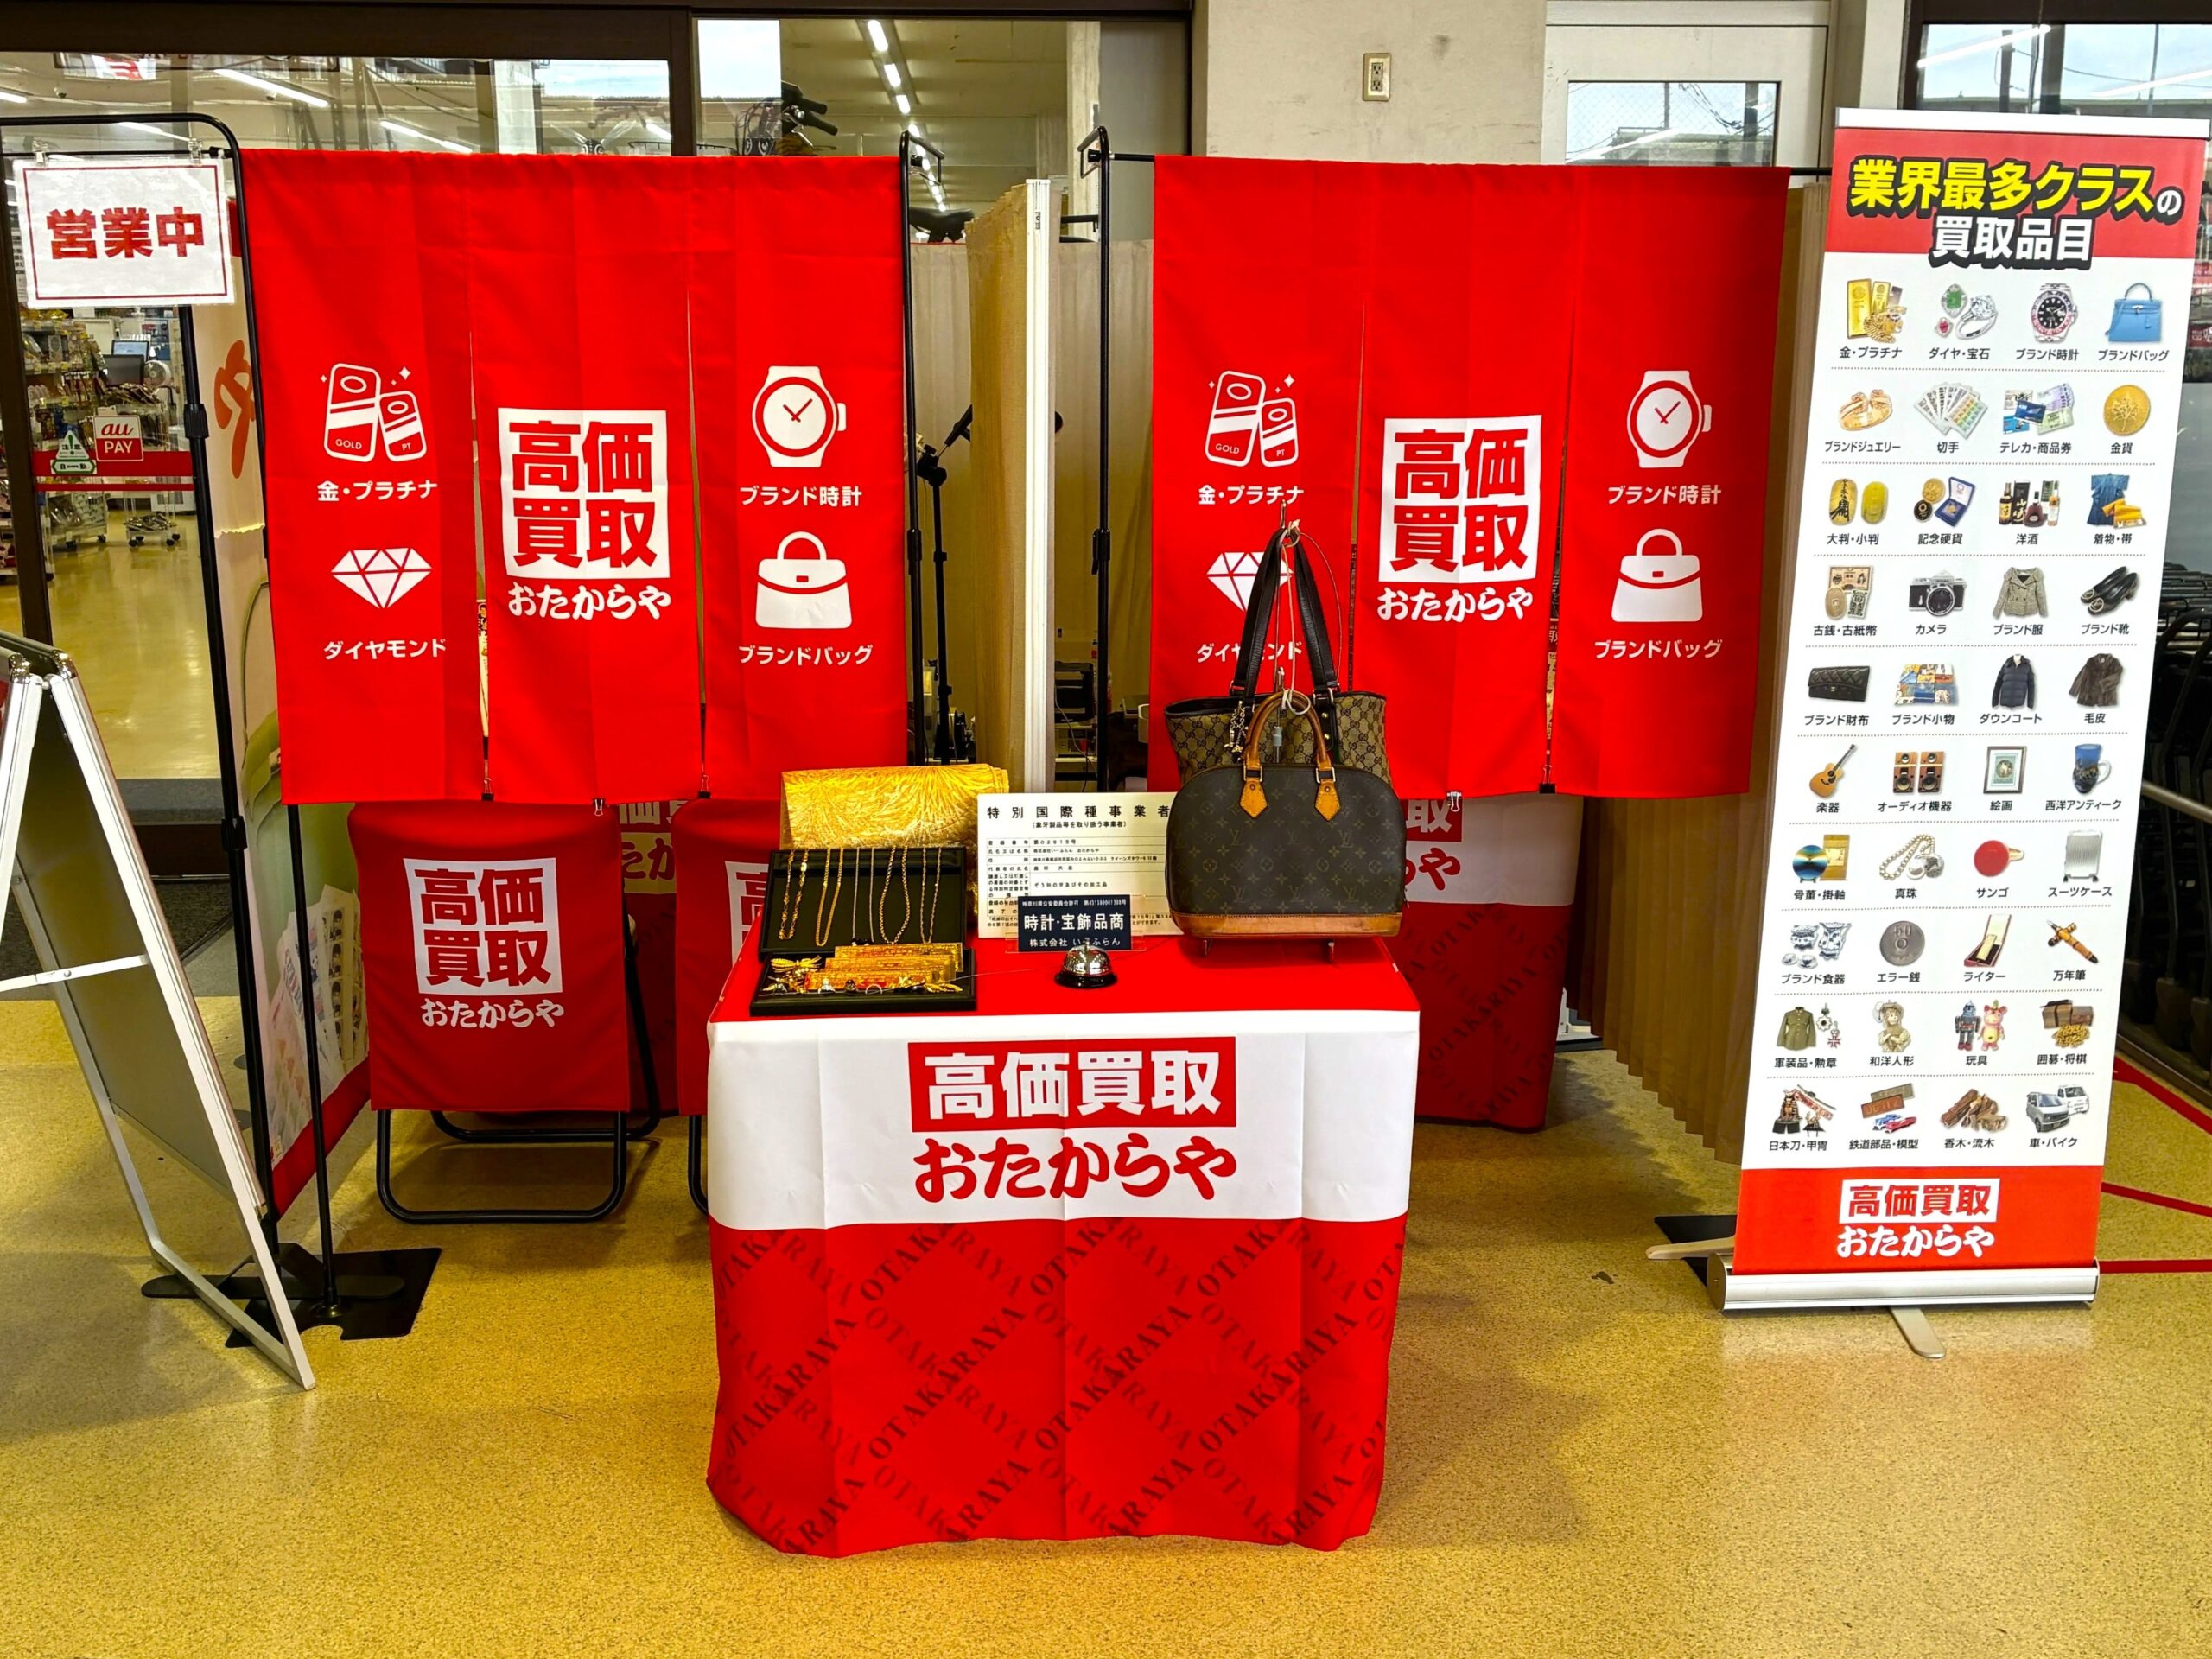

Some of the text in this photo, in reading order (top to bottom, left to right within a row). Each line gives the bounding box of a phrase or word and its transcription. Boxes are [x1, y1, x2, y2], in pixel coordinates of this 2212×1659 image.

[1849, 157, 2183, 216] 業界最多クラスの
[48, 207, 204, 258] 営業中
[1932, 214, 2093, 263] 買取品目
[1840, 346, 1903, 359] 金・プラチナ
[1929, 347, 1990, 360] ダイヤ・宝石
[2016, 348, 2080, 361] ブランド時計
[2098, 350, 2170, 361] ブランドバッグ
[100, 422, 135, 436] au
[104, 440, 134, 454] PAY
[334, 438, 363, 450] GOLD
[401, 442, 412, 452] PT
[1215, 443, 1240, 454] GOLD
[1825, 441, 1901, 453] ブランドジュエリー
[1936, 442, 1959, 454] 切手
[2000, 442, 2071, 454] テレカ・商品券
[2110, 442, 2133, 454] 金貨
[509, 420, 653, 493] 高価
[1275, 448, 1286, 457] PT
[1395, 429, 1528, 499] 高価
[318, 480, 436, 501] 金・プラチナ
[741, 486, 861, 506] ブランド時計
[1199, 485, 1303, 504] 金・プラチナ
[1609, 485, 1720, 504] ブランド時計
[512, 497, 657, 568] 買取
[1390, 504, 1529, 573] 買取
[1917, 532, 1963, 545] 記念硬貨
[1827, 533, 1879, 545] 大判・小判
[2016, 533, 2038, 545] 洋酒
[2093, 533, 2133, 545] 着物・帯
[509, 582, 671, 620] おたからや
[1378, 587, 1532, 622] おたからや
[1814, 624, 1878, 637] 古銭・古紙幣
[1915, 624, 1947, 635] カメラ
[1993, 624, 2044, 636] ブランド服
[2082, 623, 2130, 635] ブランド靴
[325, 639, 445, 659] ダイヤモンド
[740, 645, 872, 665] ブランドバッグ
[1196, 639, 1305, 665] ダインド
[1595, 640, 1720, 658] ブランドバッグ
[1805, 715, 1870, 727] ブランド財布
[1892, 714, 1955, 725] ブランド小物
[1980, 713, 2042, 724] ダウンコート
[2084, 712, 2106, 724] 毛皮
[1816, 802, 1840, 813] 楽器
[1877, 800, 1952, 812] オーディオ機器
[1989, 800, 2012, 811] 絵画
[2045, 799, 2122, 811] 西洋アンティーク
[415, 868, 543, 925] 高価
[1794, 889, 1846, 901] 骨董・掛軸
[1895, 888, 1916, 899] 真珠
[1976, 887, 2009, 899] サンゴ
[2048, 887, 2113, 898] スーツケース
[1023, 913, 1125, 931] 時計・宝飾品商
[1029, 938, 1068, 947] 株式会社
[423, 930, 551, 988] 買取
[1782, 973, 1845, 985] ブランド食器
[1877, 971, 1921, 982] エラー銭
[1964, 971, 2005, 982] ライター
[2053, 969, 2086, 982] 万年筆
[421, 1000, 564, 1028] おたからや
[1774, 1058, 1837, 1069] 軍装品・勲章
[1869, 1056, 1914, 1066] 和洋人形
[1966, 1055, 1987, 1066] 玩具
[2037, 1053, 2088, 1065] 囲碁・将棋
[925, 1051, 1220, 1119] 高価買取
[1769, 1141, 1828, 1152] 日本刀・甲冑
[1849, 1139, 1919, 1150] 鉄道部品・模型
[1944, 1138, 1994, 1149] 香木・流木
[2030, 1137, 2078, 1148] 車・バイク
[913, 1134, 1236, 1204] おたからや
[1849, 1185, 1990, 1217] 高価買取
[1836, 1224, 1995, 1258] おたからや
[868, 1305, 1027, 1460] OTAKARAYA
[1035, 1303, 1192, 1452] OTAKARAYA
